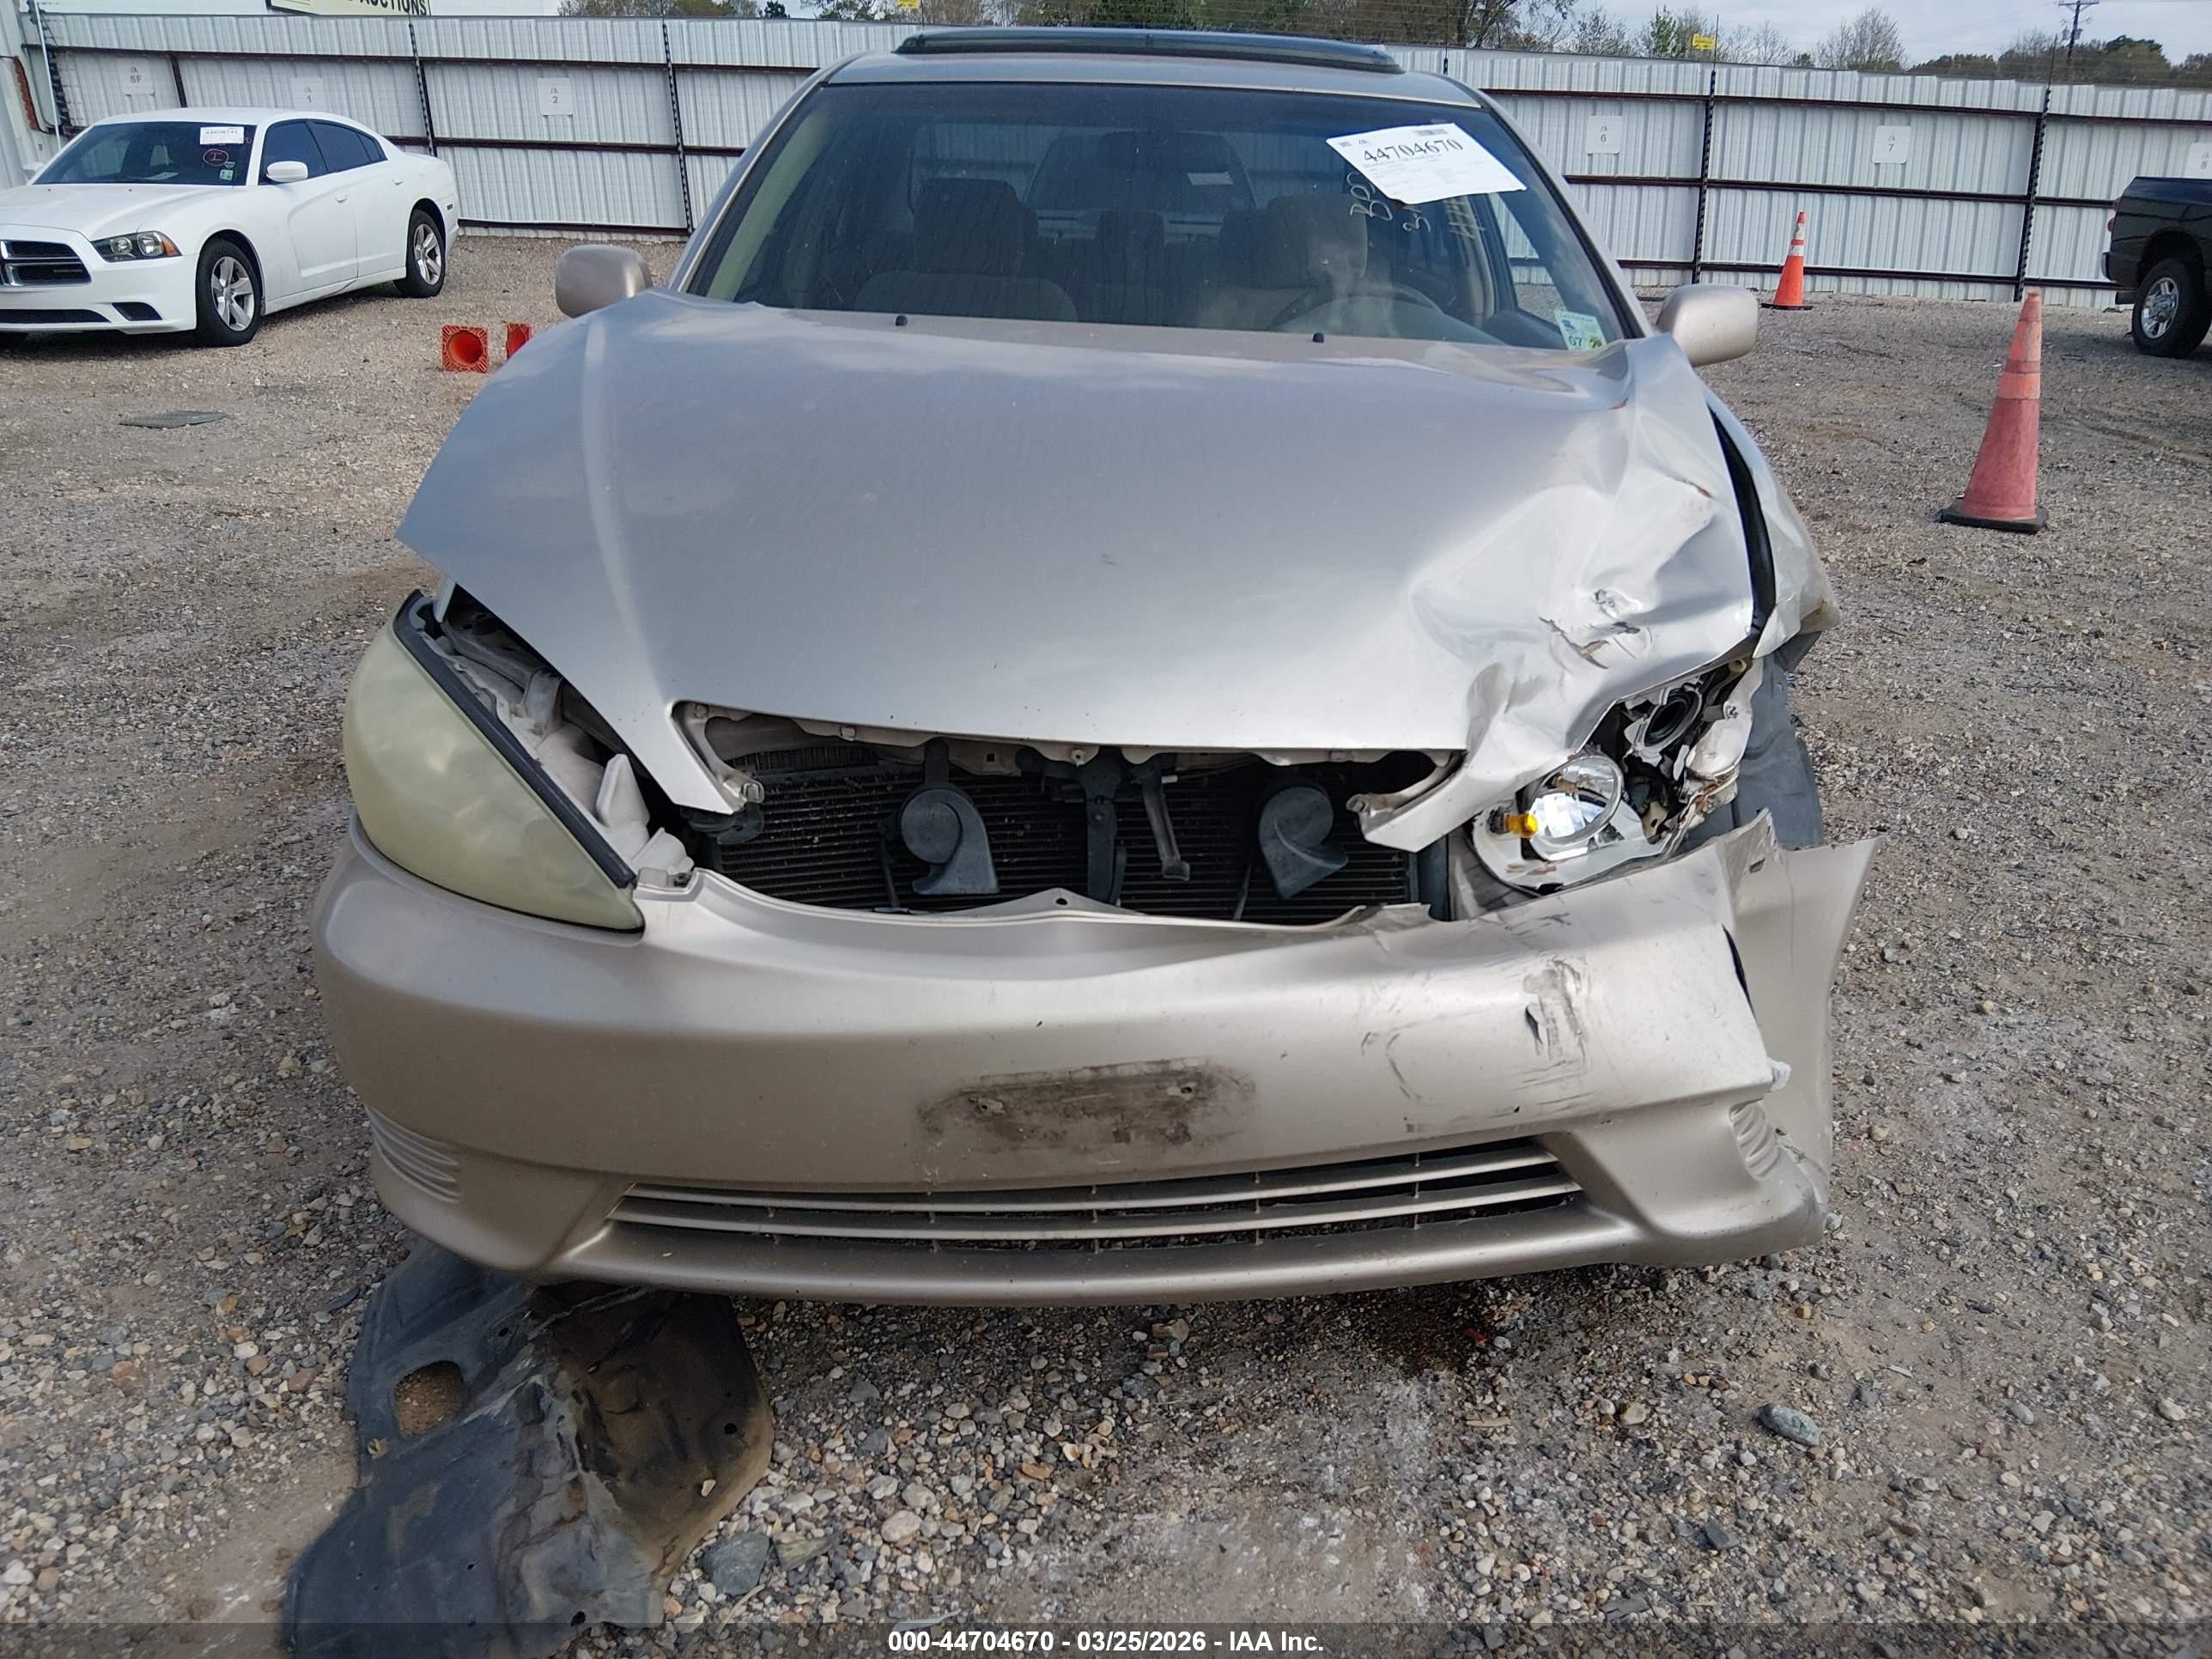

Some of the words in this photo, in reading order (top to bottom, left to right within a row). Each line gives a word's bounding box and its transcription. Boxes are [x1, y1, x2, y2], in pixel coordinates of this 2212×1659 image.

[360, 0, 427, 15] CTIONS
[552, 95, 559, 104] 2
[1600, 134, 1607, 143] 6
[1363, 138, 1463, 162] 44704670
[1888, 143, 1894, 152] 7
